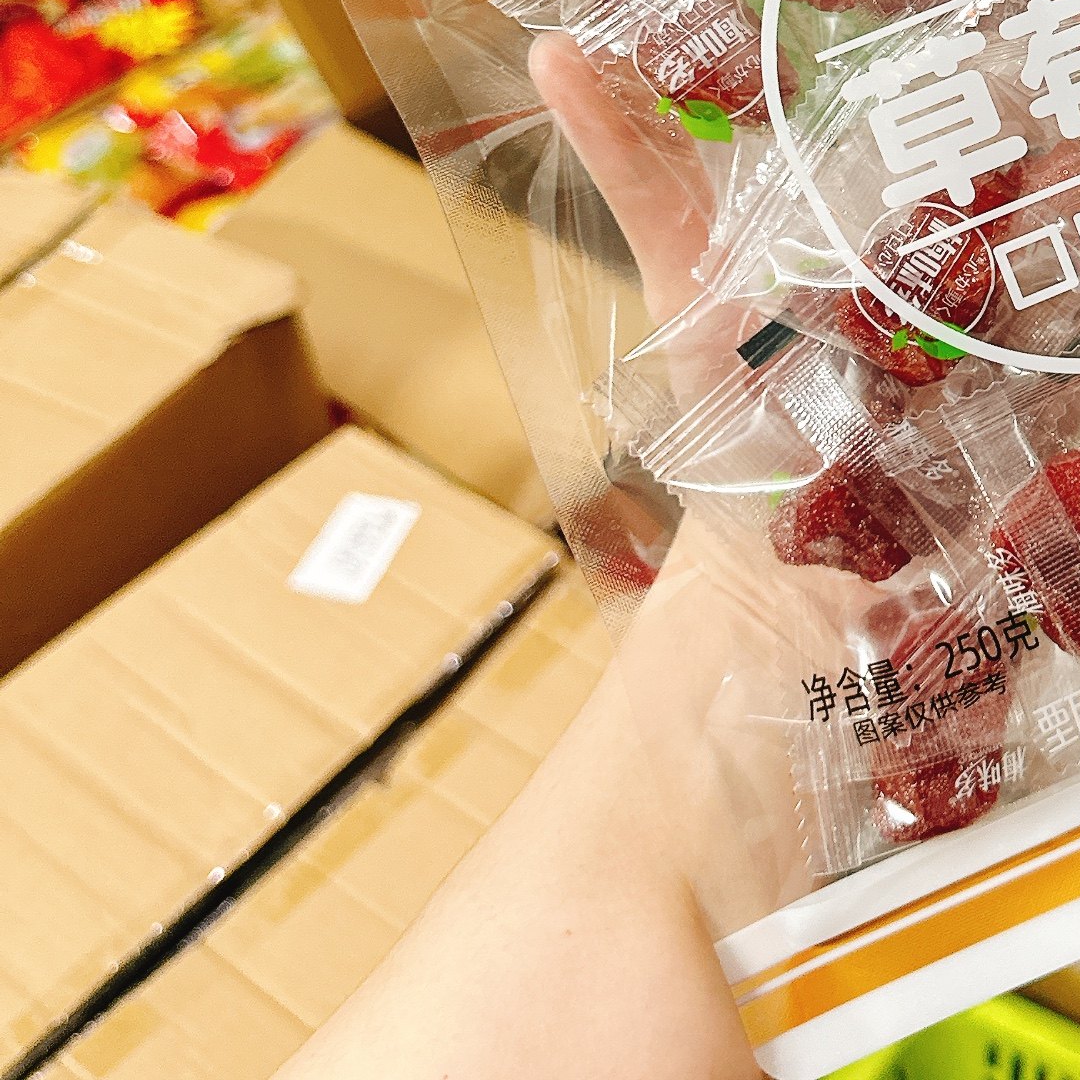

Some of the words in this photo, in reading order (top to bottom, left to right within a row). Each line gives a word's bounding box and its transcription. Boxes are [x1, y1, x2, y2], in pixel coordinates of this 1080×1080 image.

[853, 672, 1008, 747] 图案仅供参考
